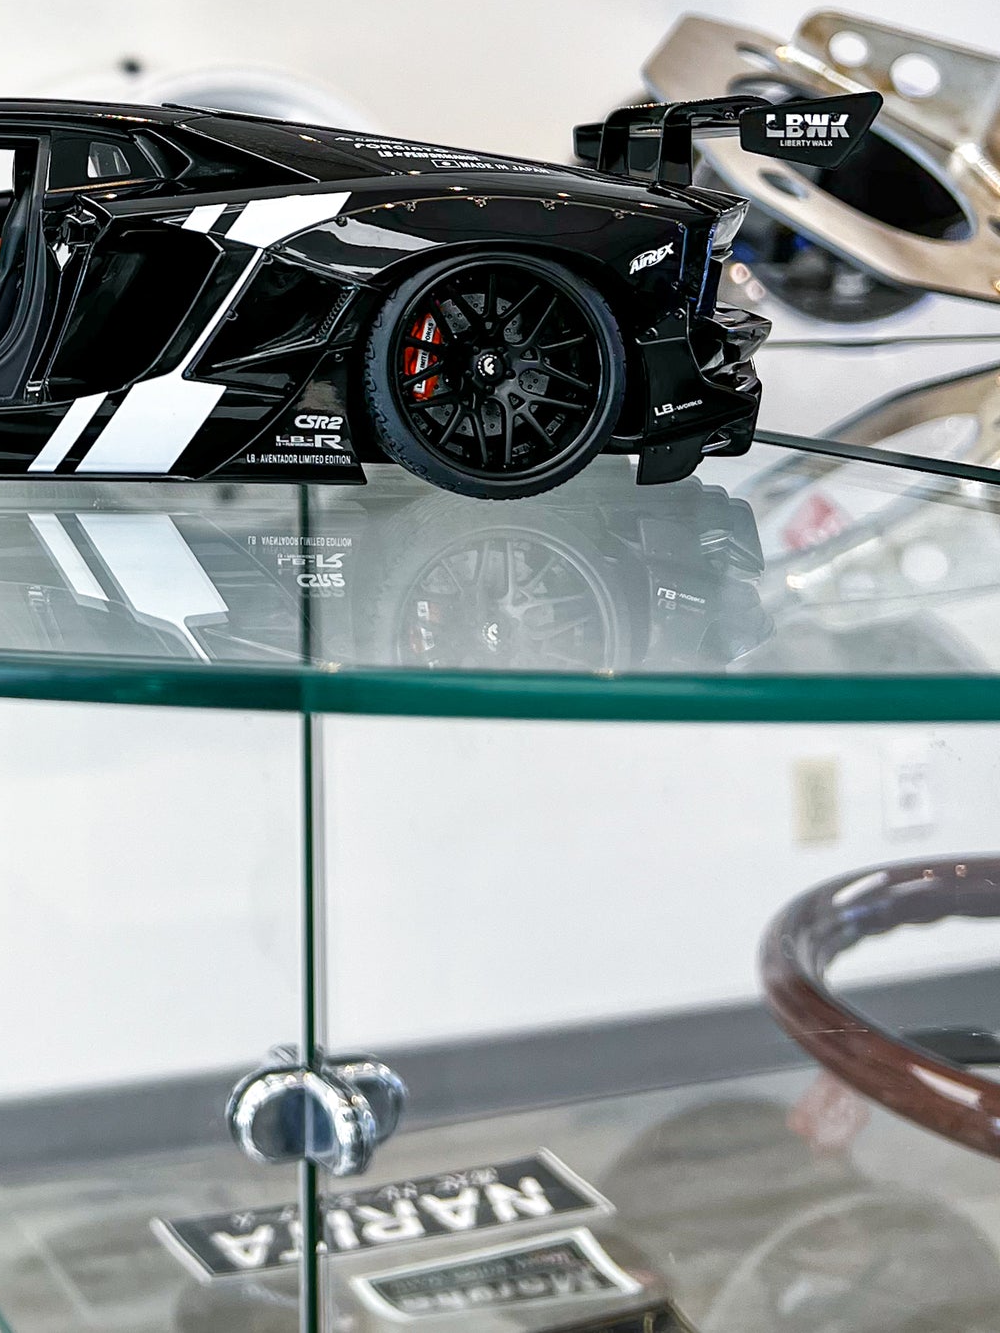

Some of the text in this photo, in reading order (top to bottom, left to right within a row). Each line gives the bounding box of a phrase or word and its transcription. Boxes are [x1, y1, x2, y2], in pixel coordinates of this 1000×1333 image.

[766, 113, 849, 138] LBWK
[780, 139, 833, 147] LIBERTY WALK
[459, 161, 494, 170] MADE
[512, 165, 550, 174] JAPAN
[294, 414, 344, 430] CSR2
[246, 453, 256, 464] LB
[260, 453, 298, 464] AVENTADOR
[299, 454, 324, 464] LIMITED
[325, 454, 351, 464] EDITION
